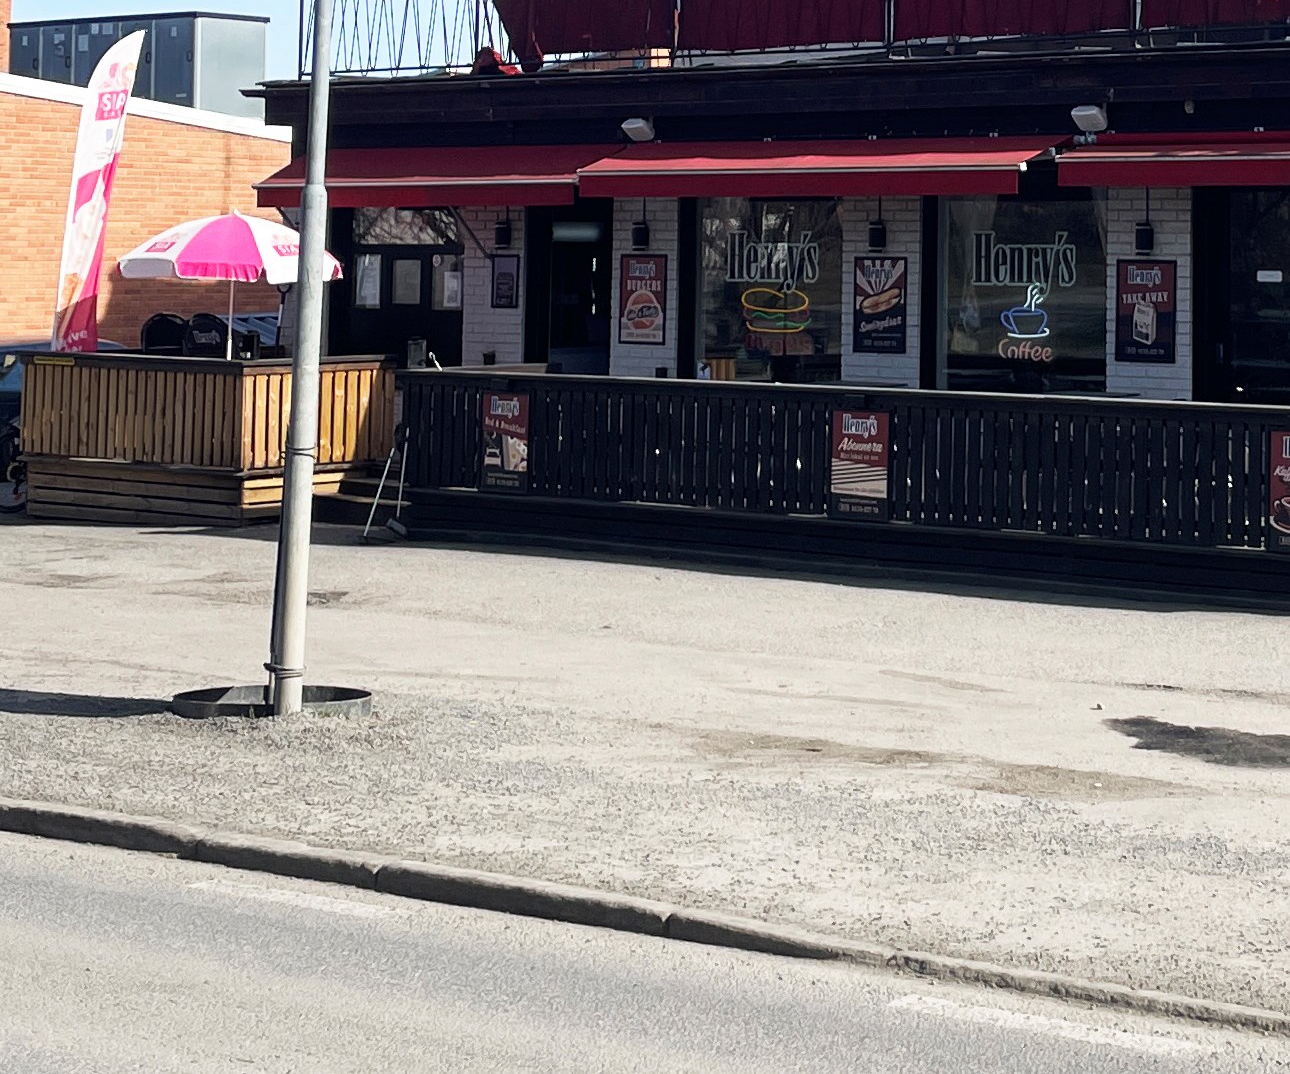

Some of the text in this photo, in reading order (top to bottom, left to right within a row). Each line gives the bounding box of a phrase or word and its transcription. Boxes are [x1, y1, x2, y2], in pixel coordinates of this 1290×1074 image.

[726, 231, 819, 293] Henry's
[972, 231, 1076, 297] Henry's
[1127, 266, 1162, 287] Henry's
[1145, 292, 1168, 303] AWAY
[998, 339, 1053, 362] Coffee
[842, 414, 878, 438] Henry's
